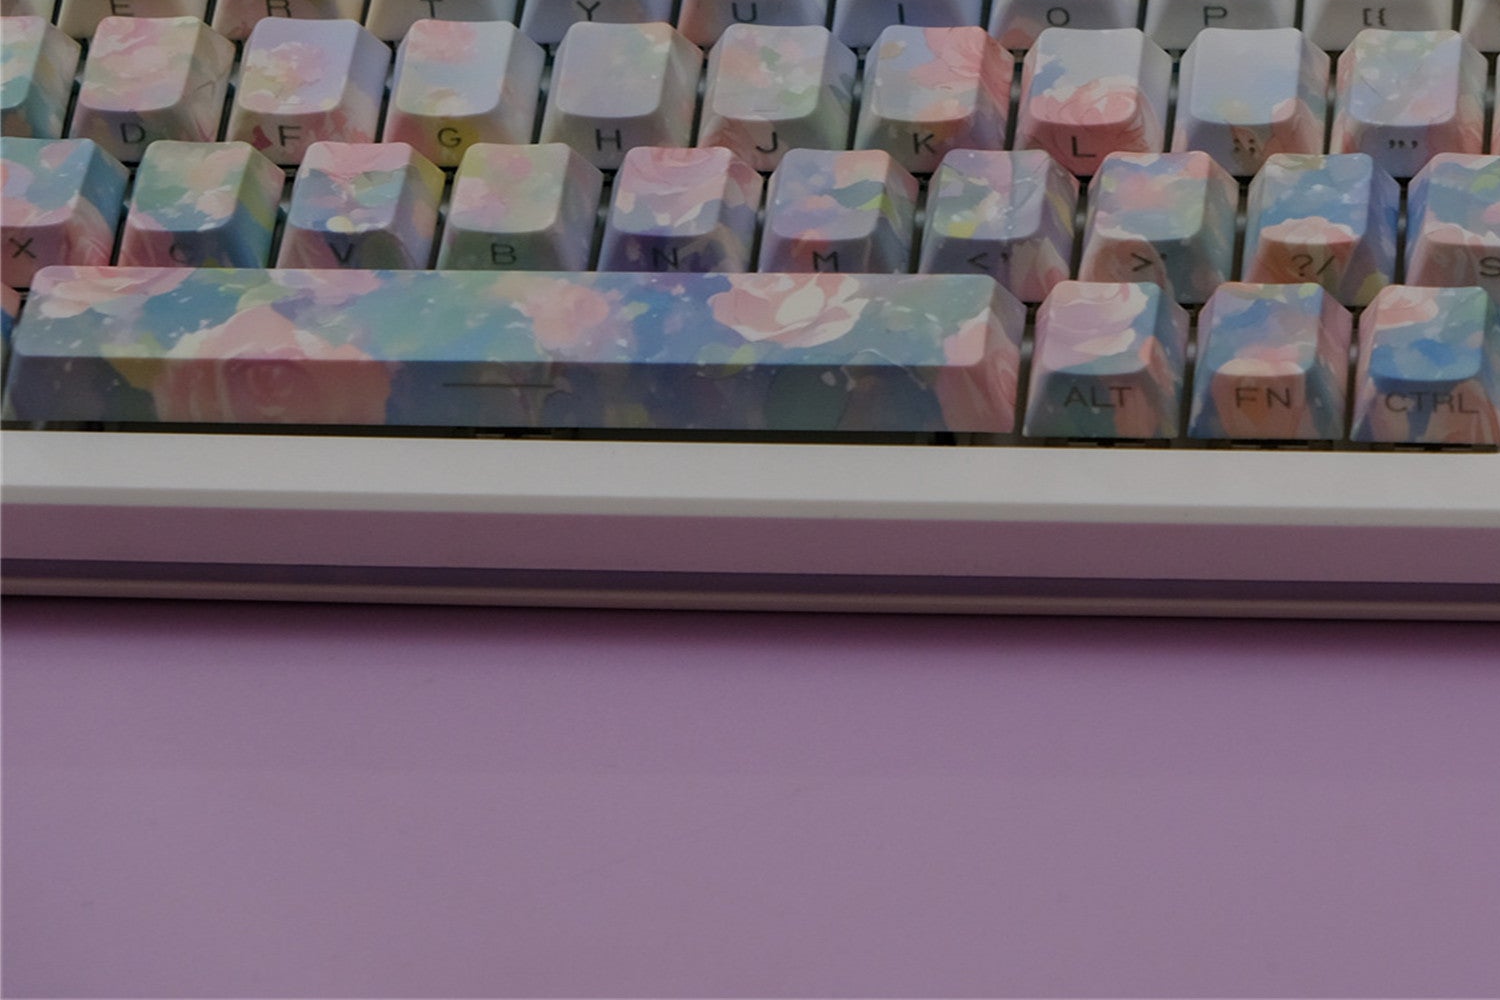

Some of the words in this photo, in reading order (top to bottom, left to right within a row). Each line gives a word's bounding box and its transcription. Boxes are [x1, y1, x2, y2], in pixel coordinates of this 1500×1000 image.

[576, 0, 600, 22] Y
[732, 2, 758, 22] U
[1046, 7, 1071, 27] O
[1204, 6, 1228, 26] P
[1363, 7, 1386, 27] [{
[121, 123, 146, 143] D
[279, 126, 301, 146] F
[438, 128, 462, 147] G
[595, 128, 621, 151] H
[756, 132, 778, 152] J
[913, 133, 937, 154] K
[1072, 136, 1097, 158] L
[9, 237, 36, 258] X
[330, 243, 354, 264] V
[491, 243, 517, 265] B
[652, 246, 679, 269] N
[812, 250, 838, 272] M
[1292, 253, 1336, 277] ?/
[1063, 386, 1132, 408] ALT
[1236, 386, 1292, 410] FN
[1385, 391, 1480, 415] CTRL
